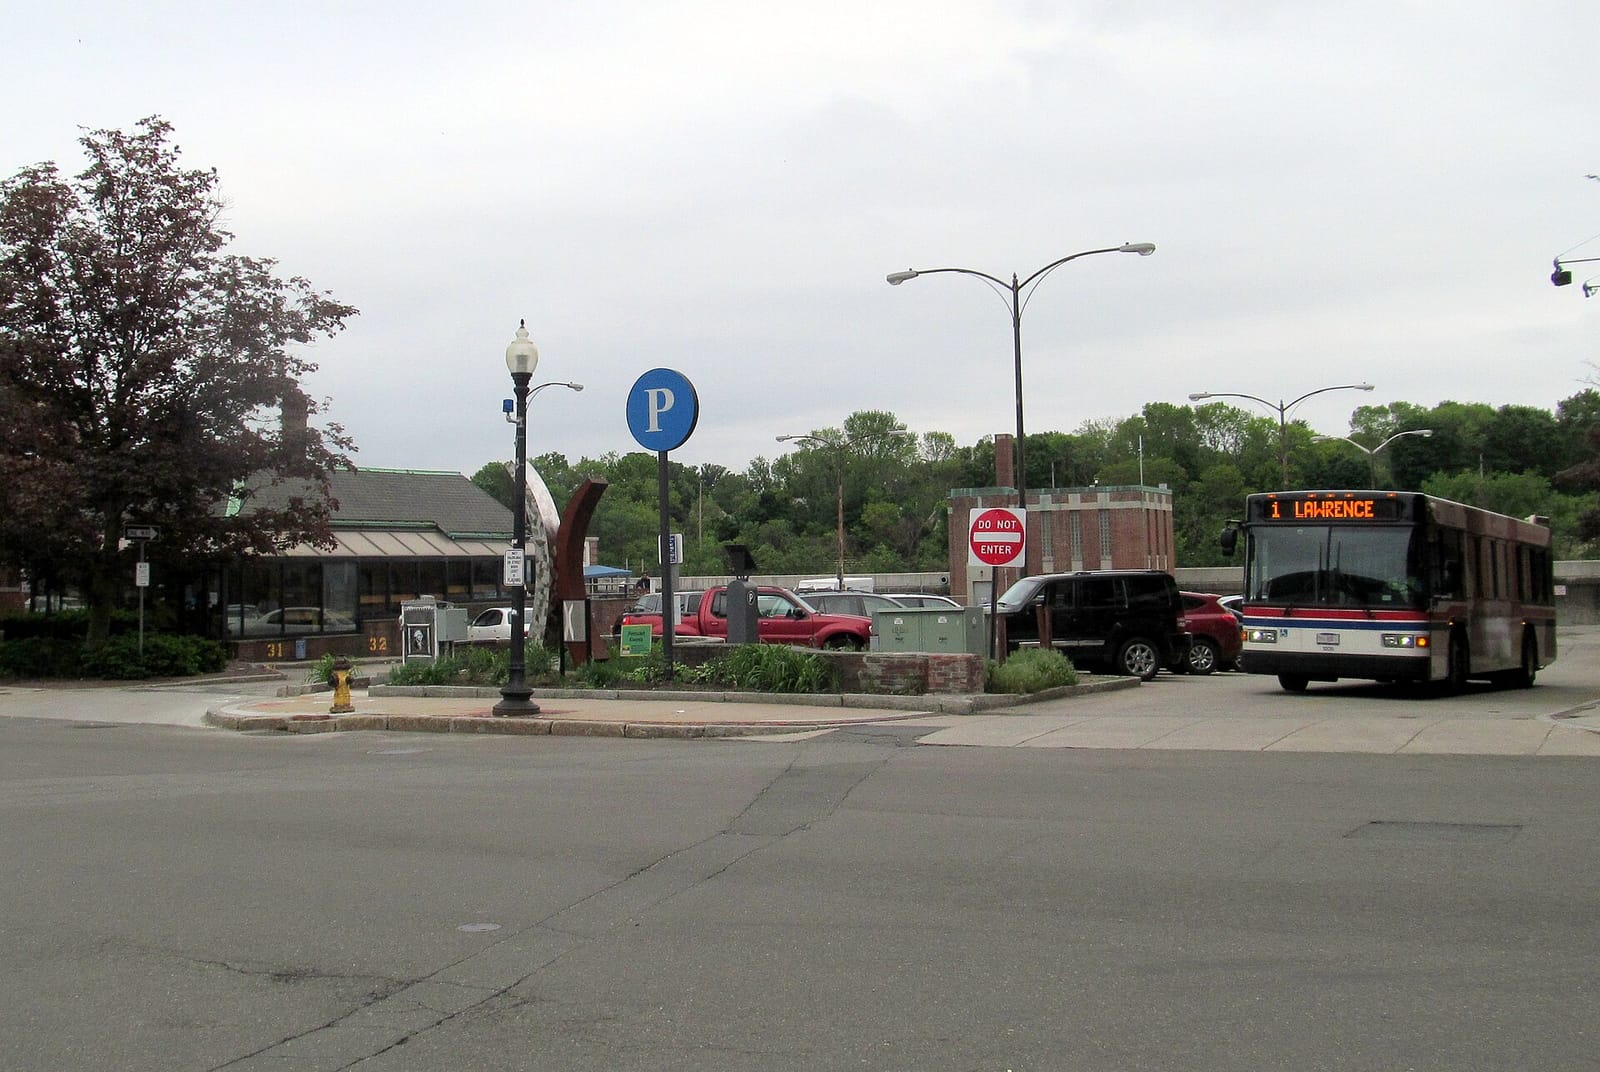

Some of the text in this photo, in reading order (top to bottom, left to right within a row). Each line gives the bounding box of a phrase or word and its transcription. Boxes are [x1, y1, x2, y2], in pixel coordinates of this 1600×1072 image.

[644, 388, 675, 433] P
[1295, 500, 1375, 518] LAWRENCE
[978, 520, 1017, 529] DO NOT
[980, 545, 1012, 554] ENTER
[267, 643, 284, 657] 31
[369, 636, 387, 651] 32
